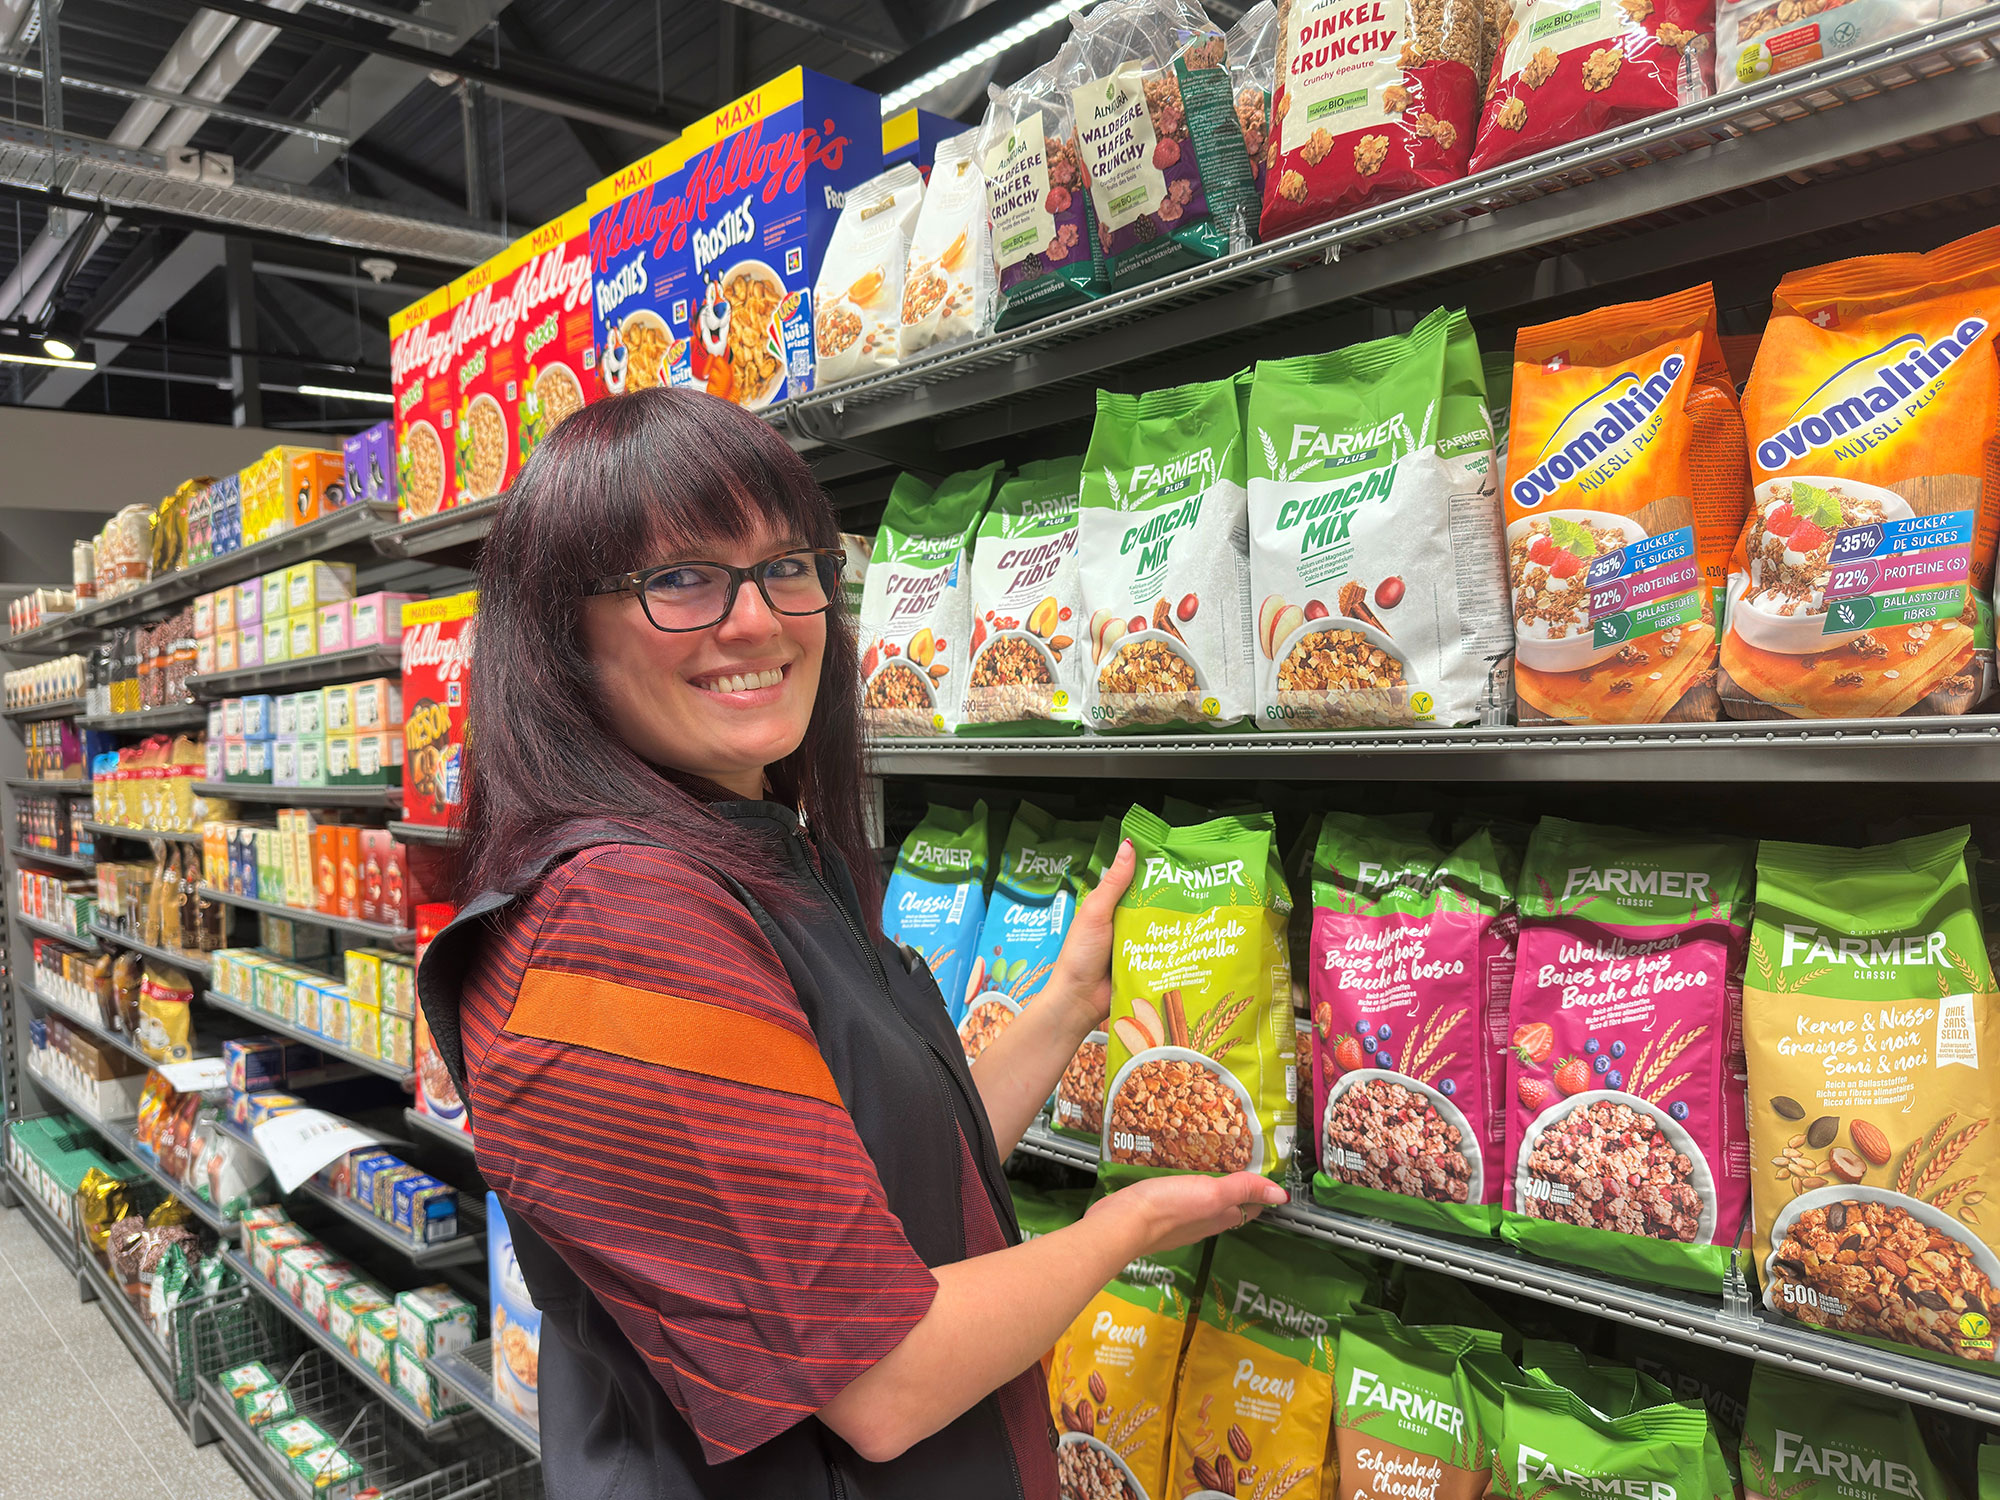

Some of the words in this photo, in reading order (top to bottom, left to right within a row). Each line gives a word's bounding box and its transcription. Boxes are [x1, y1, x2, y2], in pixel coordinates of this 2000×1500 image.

[1300, 2, 1385, 47] DINKEL
[1554, 13, 1572, 26] BIO
[1291, 29, 1397, 75] CRUNCHY
[1304, 71, 1334, 86] Crunchy
[1336, 60, 1374, 77] épeautre
[716, 94, 761, 135] MAXI
[1094, 90, 1128, 120] ALNATURA
[1329, 98, 1344, 108] BIO
[1082, 103, 1143, 144] WALDBEERE
[1097, 128, 1134, 159] HAFER
[686, 118, 848, 221] Kellogg's
[985, 153, 1042, 190] WALDBEERE
[1092, 143, 1145, 178] CRUNCHY
[614, 160, 652, 196] MAXI
[994, 174, 1031, 202] HAFER
[532, 221, 563, 252] MAXI
[693, 195, 755, 274] FROSTIES
[1013, 235, 1023, 246] BIO
[466, 265, 492, 292] MAXI
[596, 251, 648, 321] FROSTIES
[405, 302, 429, 325] MAXI
[777, 292, 801, 321] UNO
[785, 322, 810, 341] win
[1758, 320, 1985, 468] ovomaltine
[1905, 380, 1945, 418] PLUS
[1288, 413, 1404, 461] FARMER
[1437, 429, 1490, 454] FARMER
[1514, 357, 1684, 506] ovomaltine
[1632, 415, 1663, 451] PLUS
[1129, 447, 1212, 493] FARMER
[1337, 453, 1367, 466] PLUS
[1164, 481, 1184, 494] PLUS
[1044, 518, 1064, 526] PLUS
[1835, 531, 1875, 552] -35%
[1893, 539, 1907, 551] DE
[1911, 530, 1958, 547] SUCRES
[1297, 562, 1315, 571] Kalzium
[1326, 548, 1354, 561] Magnesium
[1590, 556, 1620, 577] -35%
[1635, 558, 1646, 569] DE
[1649, 545, 1685, 565] SUCRES
[1299, 568, 1318, 577] Calcium
[1305, 573, 1319, 582] Calcio
[1324, 563, 1348, 575] magnesio
[1833, 569, 1869, 589] 22%
[1884, 561, 1945, 581] PROTEINE
[1947, 557, 1967, 571] (S)
[1594, 588, 1620, 609] 22%
[1632, 574, 1680, 596] PROTEINE
[1681, 568, 1696, 580] (S)
[1883, 589, 1960, 608] BALLASTSTOFFE
[1637, 594, 1696, 620] BALLASTSTOFFE
[1904, 607, 1936, 621] FIBRES
[1655, 614, 1680, 628] FIBRES
[962, 700, 976, 712] 600
[1091, 706, 1115, 720] 600
[1266, 705, 1295, 720] 600
[1141, 858, 1245, 890] FARMER
[1560, 866, 1711, 902] FARMER
[1183, 890, 1210, 899] CLASSIC
[1616, 897, 1653, 907] CLASSIC
[1146, 920, 1181, 941] Apfel
[1183, 922, 1192, 936] &
[1850, 928, 1903, 936] ORIGINAL
[1123, 939, 1179, 957] Pommes
[1180, 937, 1187, 950] &
[1324, 950, 1373, 970] Baies
[1376, 949, 1393, 970] des
[1395, 941, 1426, 963] bois
[1559, 934, 1681, 964] Waldbeeren
[1781, 924, 1954, 969] FARMER
[1166, 955, 1174, 968] &
[1393, 960, 1407, 981] di
[1411, 960, 1464, 980] bosco
[1537, 965, 1596, 988] Baies
[1599, 960, 1632, 983] des
[1635, 954, 1672, 973] bois
[1854, 970, 1897, 980] CLASSIC
[1561, 983, 1628, 1009] Bacche
[1631, 975, 1650, 997] di
[1653, 971, 1708, 994] bosco
[1796, 1015, 1857, 1035] Kerne
[1860, 1012, 1876, 1032] &
[1879, 1006, 1935, 1029] Nüsse
[1944, 1017, 1966, 1028] SANS
[1946, 1006, 1965, 1017] OHNE
[1777, 1036, 1858, 1056] Graines
[1862, 1034, 1877, 1052] &
[1881, 1031, 1922, 1051] noix
[1941, 1029, 1969, 1040] SENZA
[1822, 1055, 1873, 1076] Semi
[1876, 1055, 1892, 1074] &
[1894, 1048, 1928, 1071] noci
[1816, 1090, 1836, 1098] Riche
[1874, 1083, 1914, 1096] alimentaires
[1858, 1076, 1907, 1088] Ballaststoffen
[1823, 1099, 1843, 1107] Ricco
[1874, 1093, 1907, 1104] alimentari
[1114, 1132, 1134, 1150] 500
[1524, 1176, 1550, 1200] 500
[1784, 1284, 1817, 1307] 500
[1232, 1280, 1328, 1352] FARMER
[1091, 1311, 1147, 1348] Pecan
[1233, 1359, 1295, 1403] Pecan
[1346, 1367, 1464, 1444] FARMER
[1397, 1419, 1428, 1436] CLASSIC
[1356, 1448, 1442, 1479] Schokolade
[1517, 1443, 1677, 1500] FARMER
[1773, 1429, 1924, 1500] FARMER
[1372, 1471, 1440, 1500] Chocolat
[1837, 1485, 1878, 1500] CLASSIC
